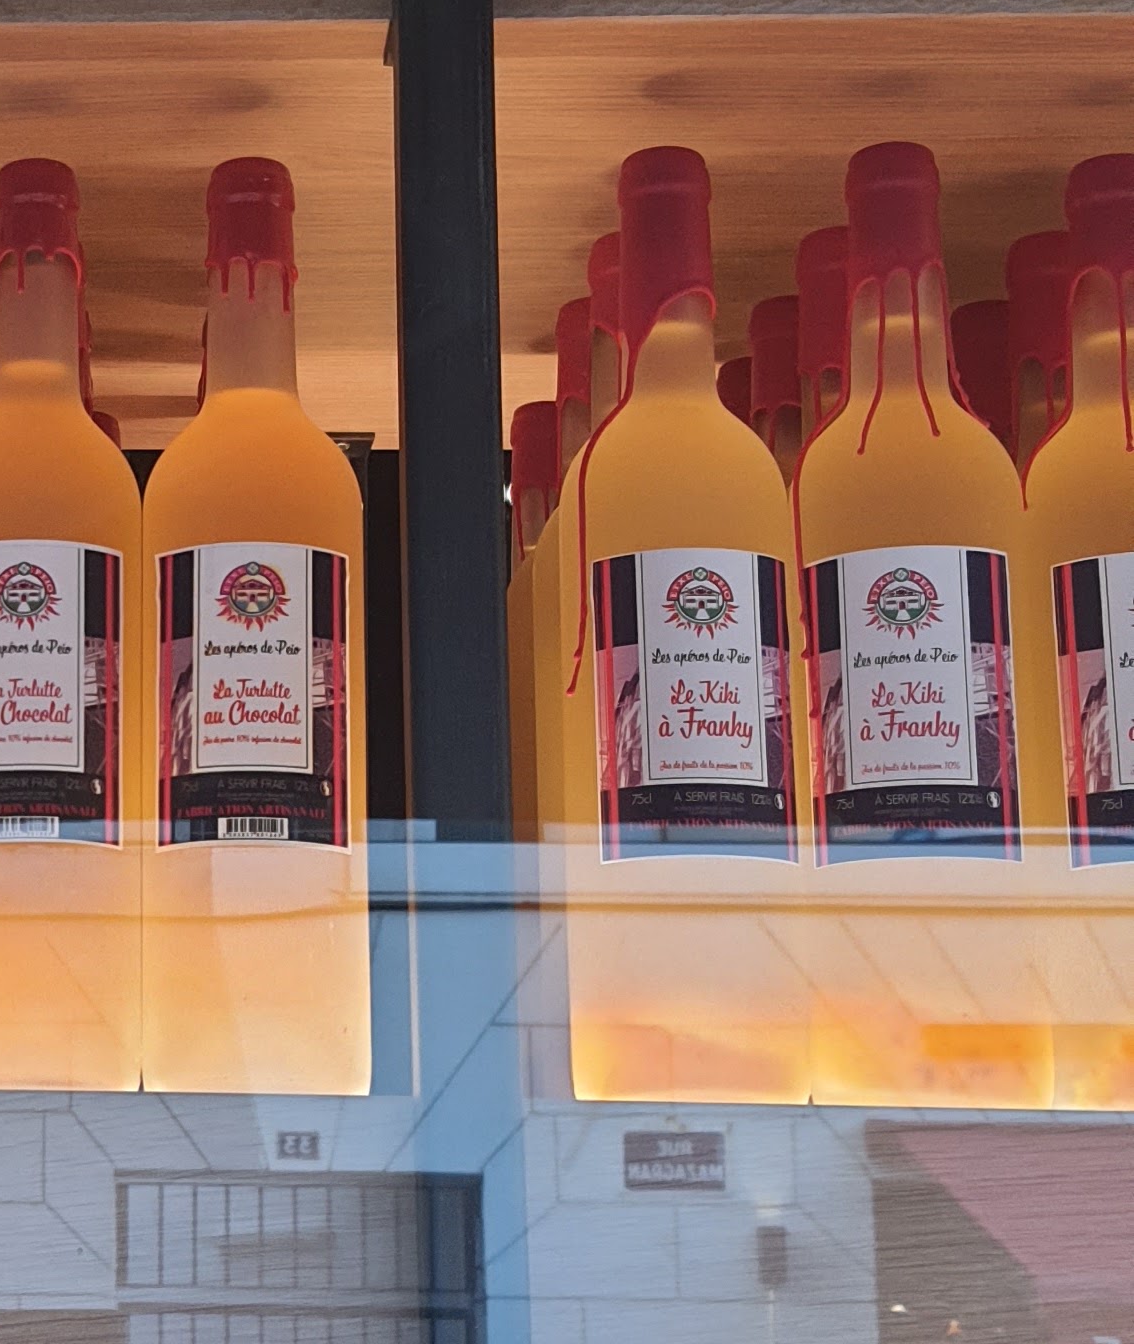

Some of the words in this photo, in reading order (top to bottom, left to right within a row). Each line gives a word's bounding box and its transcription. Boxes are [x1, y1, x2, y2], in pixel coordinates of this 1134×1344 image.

[31, 640, 45, 655] de
[46, 639, 73, 655] Peio
[204, 640, 221, 657] Les
[224, 641, 258, 659] apéros
[260, 640, 273, 655] de
[274, 639, 301, 656] Peio
[651, 647, 671, 665] Les
[673, 649, 710, 668] apéros
[713, 648, 726, 663] de
[727, 648, 751, 665] Peio
[853, 651, 872, 669] Les
[874, 651, 911, 669] apéros
[914, 648, 928, 663] de
[929, 647, 959, 663] Peio
[7, 678, 63, 699] Turlutte
[213, 678, 233, 700] La
[236, 678, 292, 700] Turlutte
[670, 678, 696, 705] Le
[698, 679, 741, 705] Kiki
[871, 681, 897, 708] Le
[899, 681, 946, 705] Kiki
[0, 699, 73, 726] Chocolat
[203, 710, 224, 726] au
[228, 699, 301, 726] Chocolat
[658, 714, 674, 738] à
[676, 706, 754, 749] Franky
[860, 718, 875, 742] à
[877, 708, 961, 748] Franky
[944, 760, 961, 770] 10%
[631, 793, 652, 806] 75cl
[685, 791, 718, 803] SERVIR
[719, 791, 745, 804] FRAIS
[885, 793, 920, 805] SERVIR
[921, 792, 951, 804] FRAIS
[1101, 798, 1124, 812] 75cl
